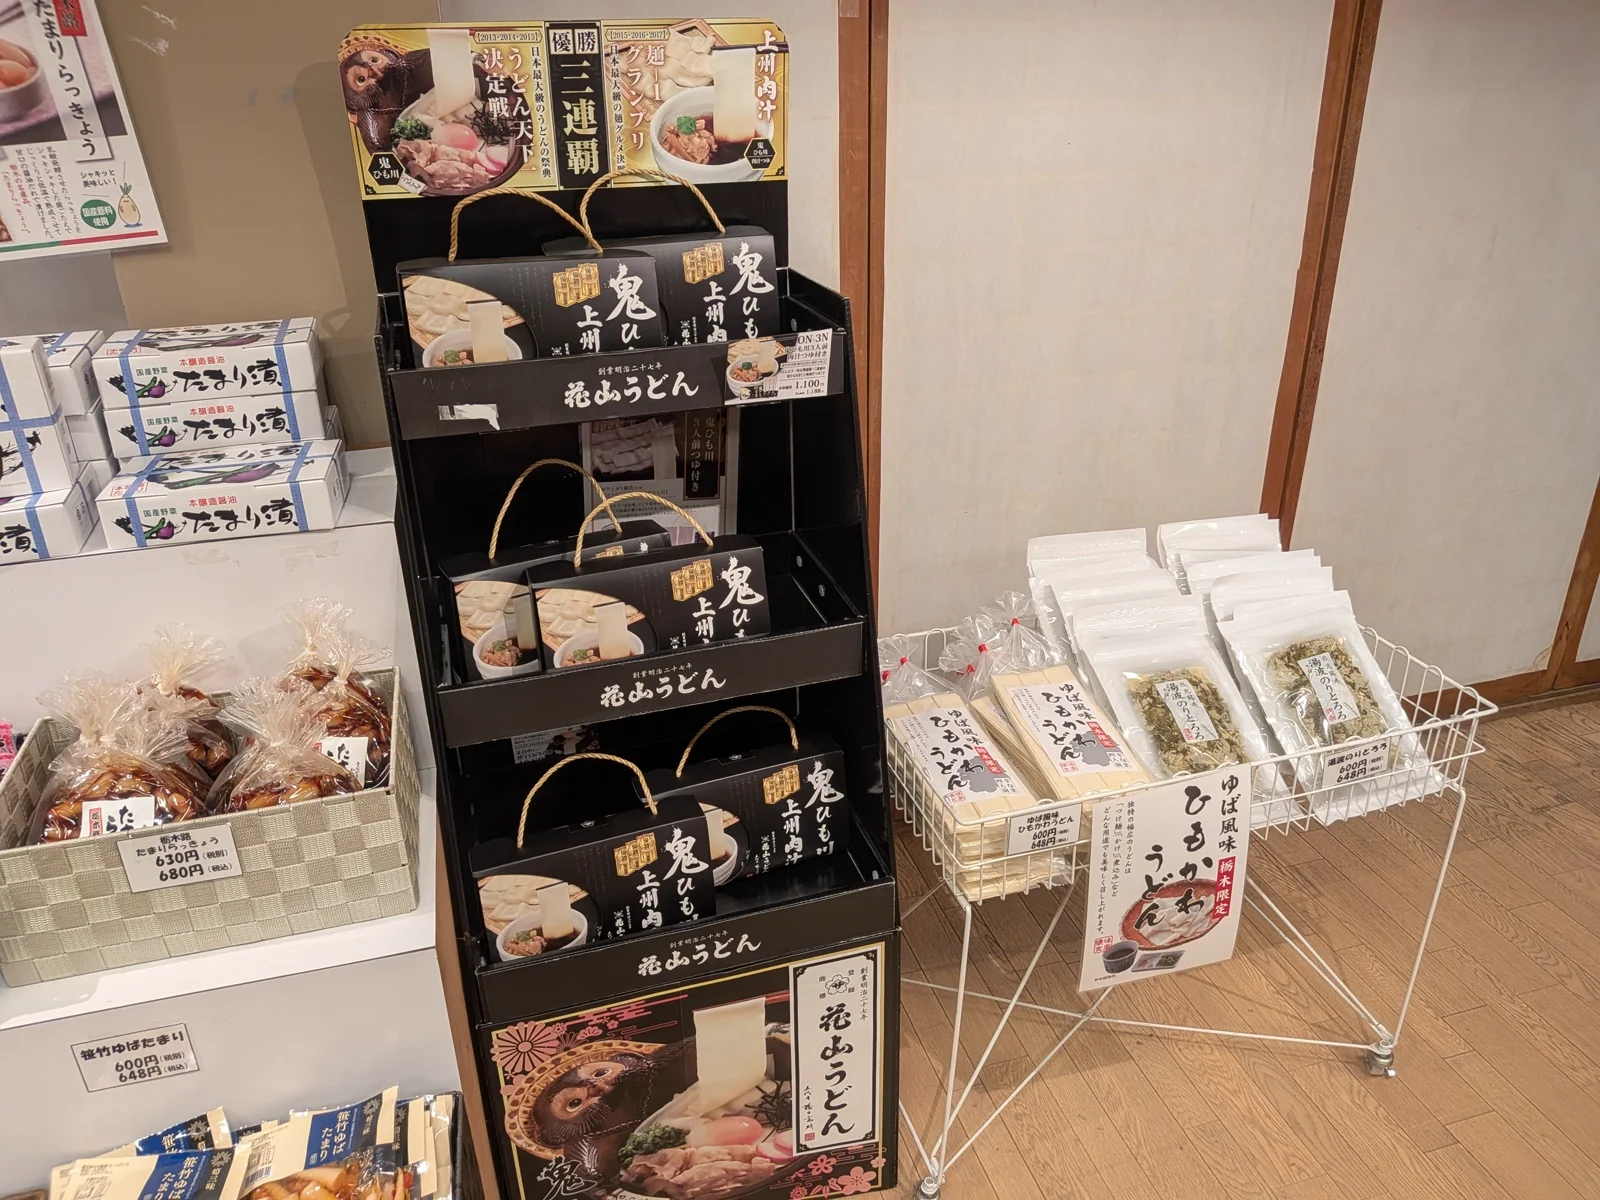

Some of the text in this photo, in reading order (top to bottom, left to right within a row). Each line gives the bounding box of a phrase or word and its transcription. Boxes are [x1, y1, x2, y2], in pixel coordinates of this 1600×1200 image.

[551, 30, 597, 52] 優勝
[33, 0, 96, 156] たまりらっきょう
[483, 47, 510, 117] 決定戦
[756, 29, 779, 122] 上州肉汁
[508, 46, 537, 172] うどん天下一
[530, 46, 552, 178] 日本最大級のうどんの祭典
[627, 45, 648, 151] グランプリ
[559, 59, 600, 176] 三連覇
[80, 169, 115, 179] シャキッと
[373, 169, 400, 180] ひも川
[379, 156, 391, 169] 鬼
[82, 205, 113, 217] 国産原料
[93, 216, 110, 227] 使用
[605, 261, 657, 350] 鬼ひ
[730, 241, 775, 340] 鬼ひも
[577, 304, 603, 353] 上州
[703, 281, 728, 343] 上州肉
[787, 351, 828, 361] 肉汁つゆ付き
[797, 332, 829, 345] ON-3N
[136, 366, 168, 377] 国産野菜
[173, 358, 283, 393] たまり漬
[179, 355, 225, 367] 本醸造醤油
[598, 361, 663, 376] 創業明治二十七年
[564, 371, 700, 408] 花山うどん
[147, 416, 179, 427] 国産野菜
[182, 406, 292, 441] たまり漬
[189, 404, 235, 417] 本醸造醤油
[690, 417, 702, 492] 3人前つゆ付き
[704, 416, 716, 462] 鬼ひも川
[143, 507, 177, 518] 国産野菜
[182, 497, 299, 534] たまり漬
[188, 495, 237, 507] 本醸造醤油
[692, 597, 717, 643] 上州
[600, 668, 727, 708] 花山うどん
[632, 662, 693, 679] 創業明治二十七年
[1309, 657, 1347, 720] 湯波のりとろろ
[1041, 692, 1096, 747] ひもかわ
[1058, 683, 1096, 721] ゆば風味
[1166, 682, 1205, 740] 湯波のりとろろ
[929, 716, 984, 773] ひもかわ
[947, 709, 984, 746] ゆば風味
[1042, 719, 1081, 761] うどん
[930, 746, 968, 791] うどん
[1327, 742, 1387, 767] 湯波のりとろろ
[1339, 758, 1367, 774] 600円
[1337, 767, 1367, 783] 648円
[804, 760, 845, 856] 鬼ひも川
[1018, 815, 1074, 834] ひもかわうどん
[1026, 810, 1060, 824] ゆば風味
[1217, 774, 1241, 854] ゆば風味
[136, 836, 219, 857] たまりらっきょう
[159, 832, 192, 845] 栃木路
[781, 799, 803, 866] 上州肉汁
[1031, 836, 1056, 849] 648円
[1032, 827, 1057, 840] 600円
[1125, 800, 1135, 874] 独特の幅広のうどんは
[1174, 785, 1213, 915] ひもかわ
[156, 849, 200, 867] 630円
[159, 863, 204, 882] 680円
[636, 870, 662, 929] 上州肉
[1133, 843, 1173, 930] うどん
[1215, 860, 1234, 915] 栃木限定
[637, 934, 762, 977] 花山うどん
[669, 930, 729, 948] 創業明治二十七年
[859, 966, 869, 1022] 創業明治二十七年
[80, 1031, 184, 1061] 笹竹ゆばたまり
[115, 1054, 160, 1073] 600円
[119, 1065, 162, 1083] 648円
[819, 1002, 856, 1137] 花山うどん
[318, 1127, 333, 1162] たまり
[332, 1110, 351, 1156] 笹竹ゆば
[153, 1172, 176, 1200] たまり
[168, 1156, 199, 1200] 笹竹ゆば
